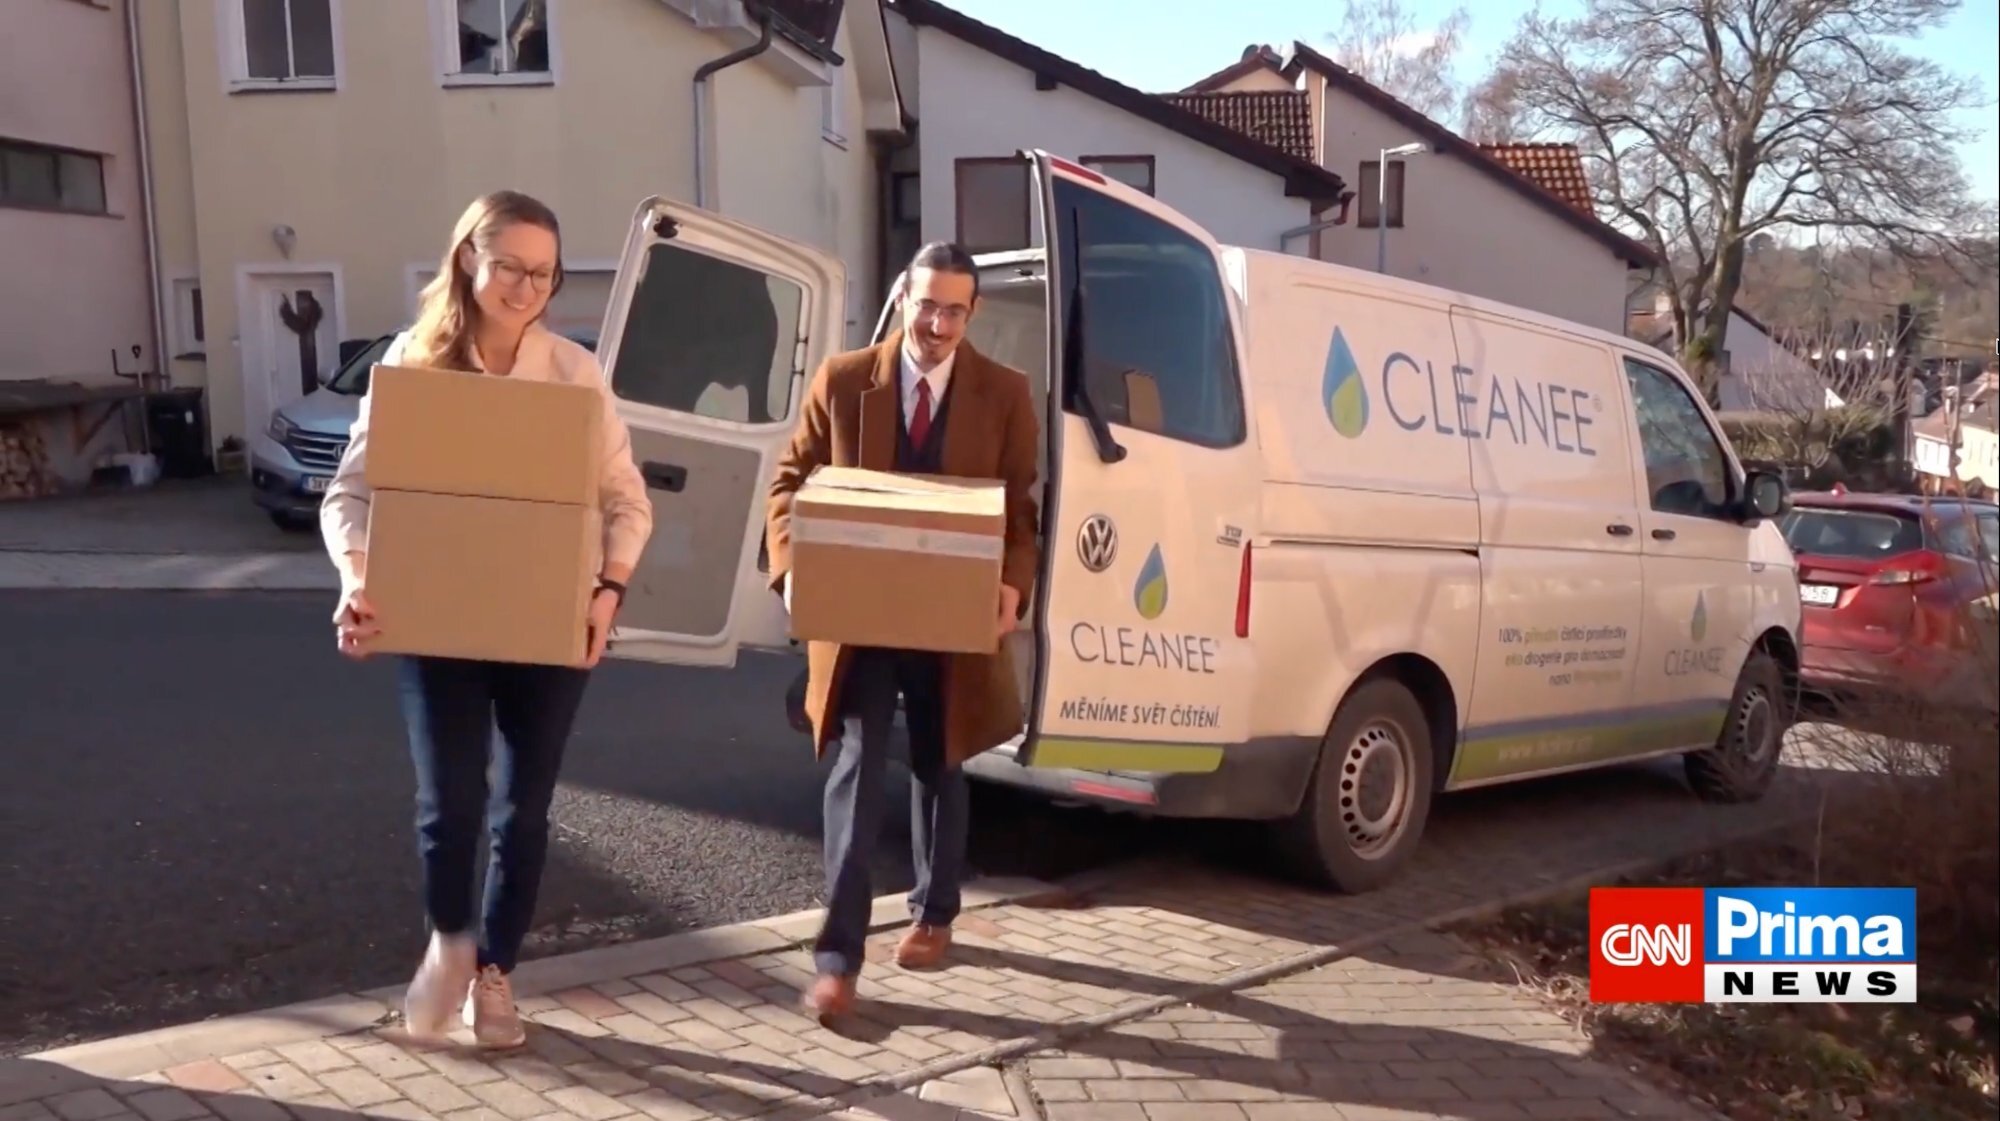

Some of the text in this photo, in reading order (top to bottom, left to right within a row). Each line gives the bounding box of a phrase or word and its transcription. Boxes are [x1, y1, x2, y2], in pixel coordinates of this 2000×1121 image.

[1382, 351, 1597, 456] CLEANEE
[1070, 621, 1216, 674] CLEANEE
[1059, 696, 1128, 722] MĚNÍME
[1132, 702, 1167, 725] SVĚT
